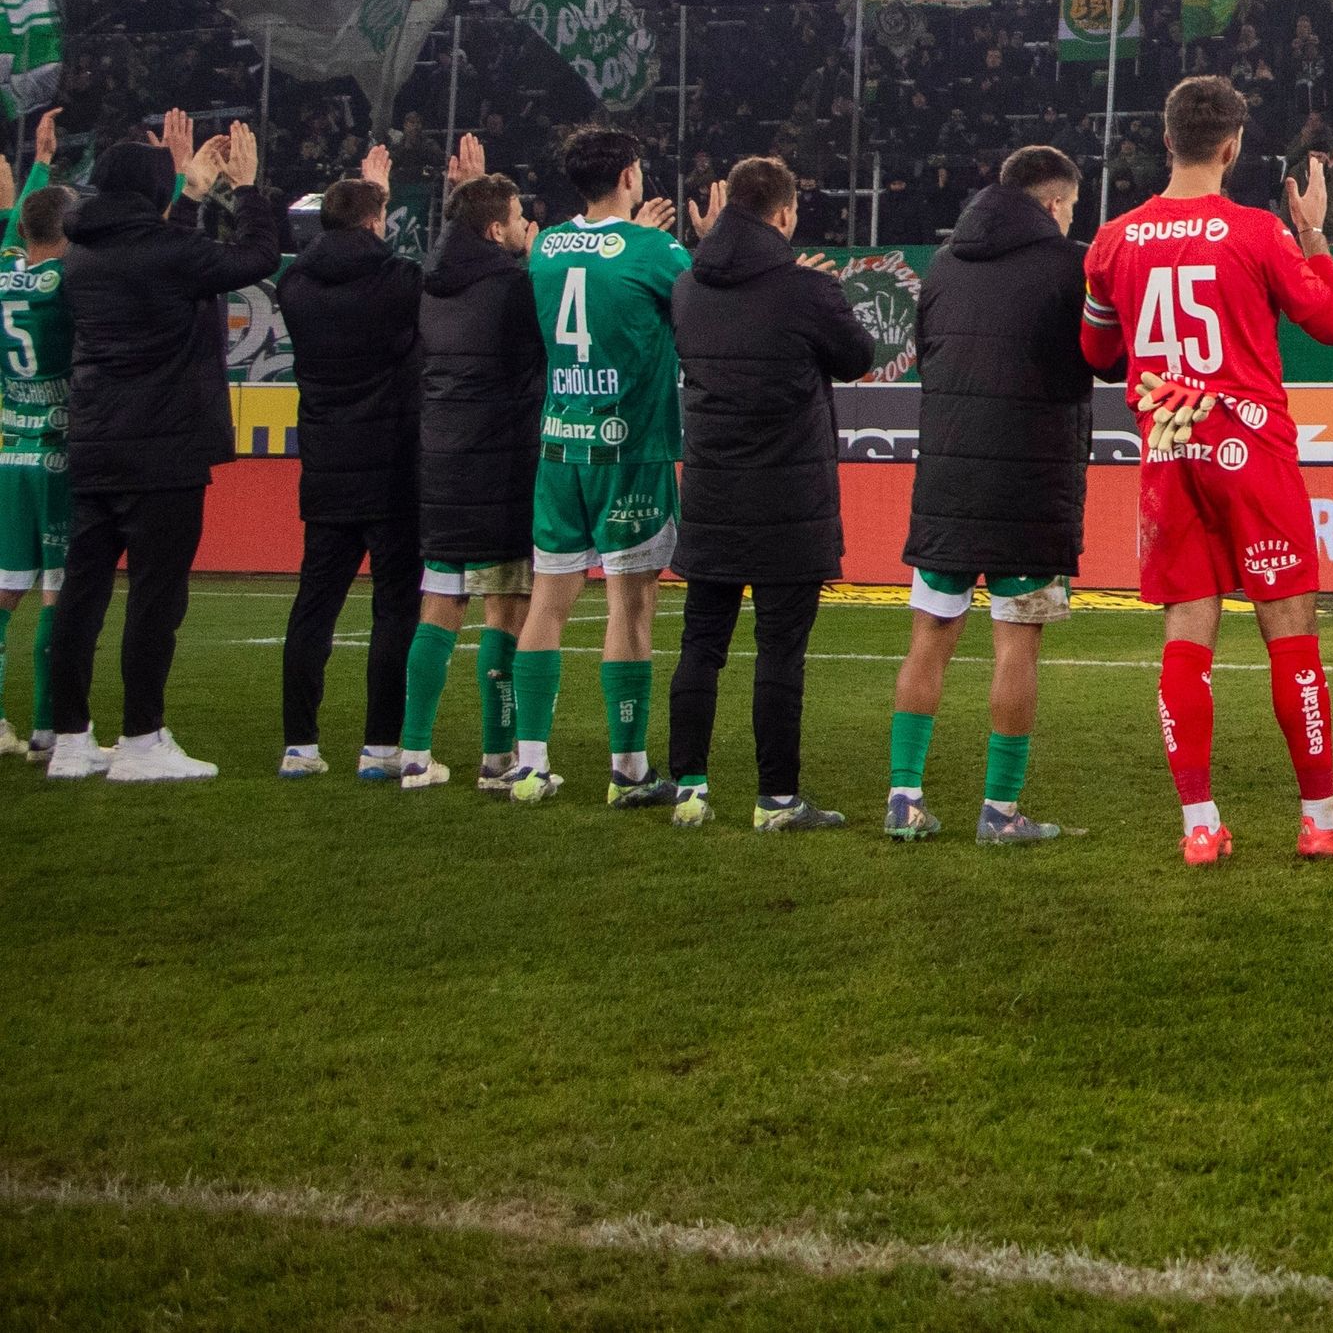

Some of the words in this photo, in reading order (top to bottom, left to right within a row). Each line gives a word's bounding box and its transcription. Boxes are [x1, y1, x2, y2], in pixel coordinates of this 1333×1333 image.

[541, 232, 601, 257] spusu
[1125, 218, 1203, 246] spusu
[1, 300, 38, 378] 5
[555, 267, 593, 363] 4
[1134, 265, 1223, 375] 45
[541, 417, 596, 439] Allianz
[1246, 539, 1290, 557] WIENER
[1302, 685, 1325, 756] easystaff
